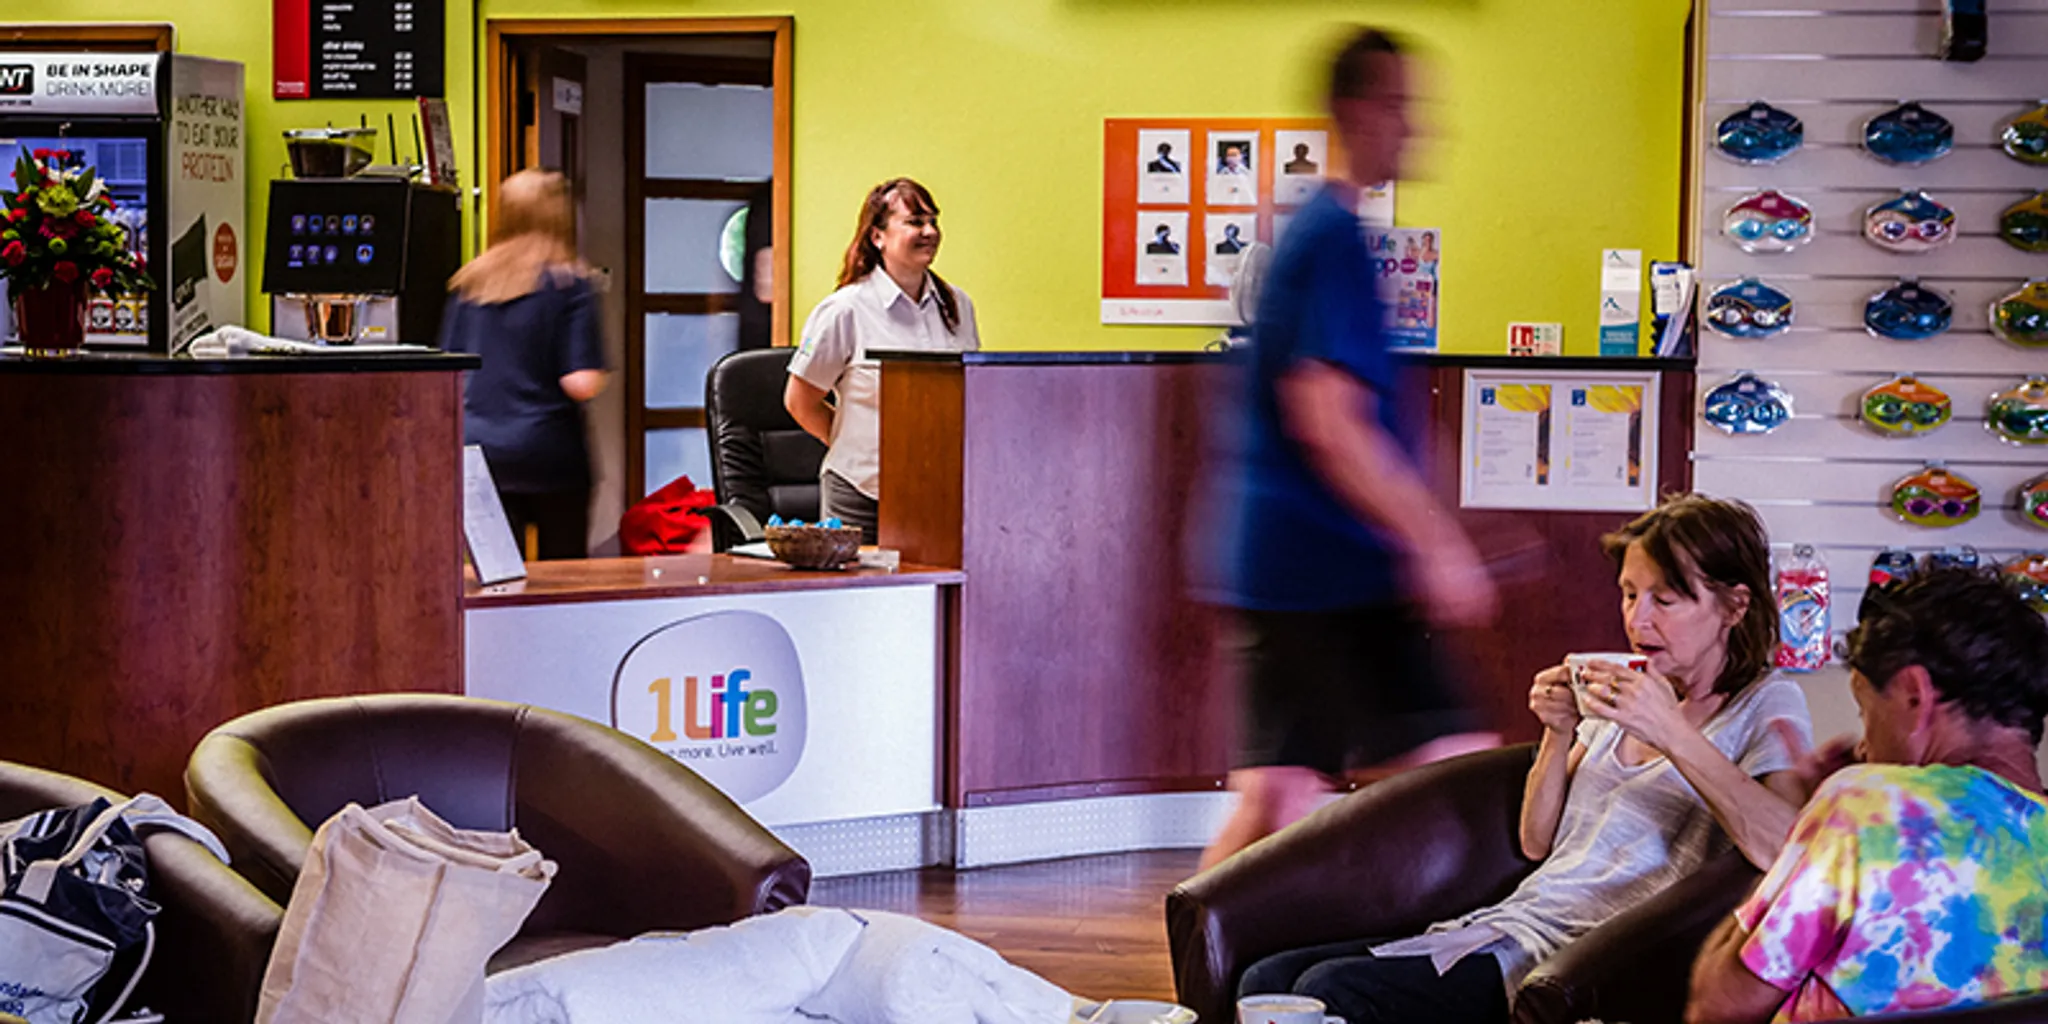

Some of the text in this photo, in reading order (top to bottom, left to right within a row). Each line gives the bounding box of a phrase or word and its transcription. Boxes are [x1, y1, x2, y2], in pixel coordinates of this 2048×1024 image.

[46, 63, 152, 78] BE IN SHAPE
[46, 80, 98, 96] DRINK
[176, 93, 219, 118] ANOTHER
[176, 120, 239, 149] TO EAT YOUR
[182, 151, 235, 183] PROTEIN
[678, 746, 715, 759] more.
[718, 742, 746, 758] Live
